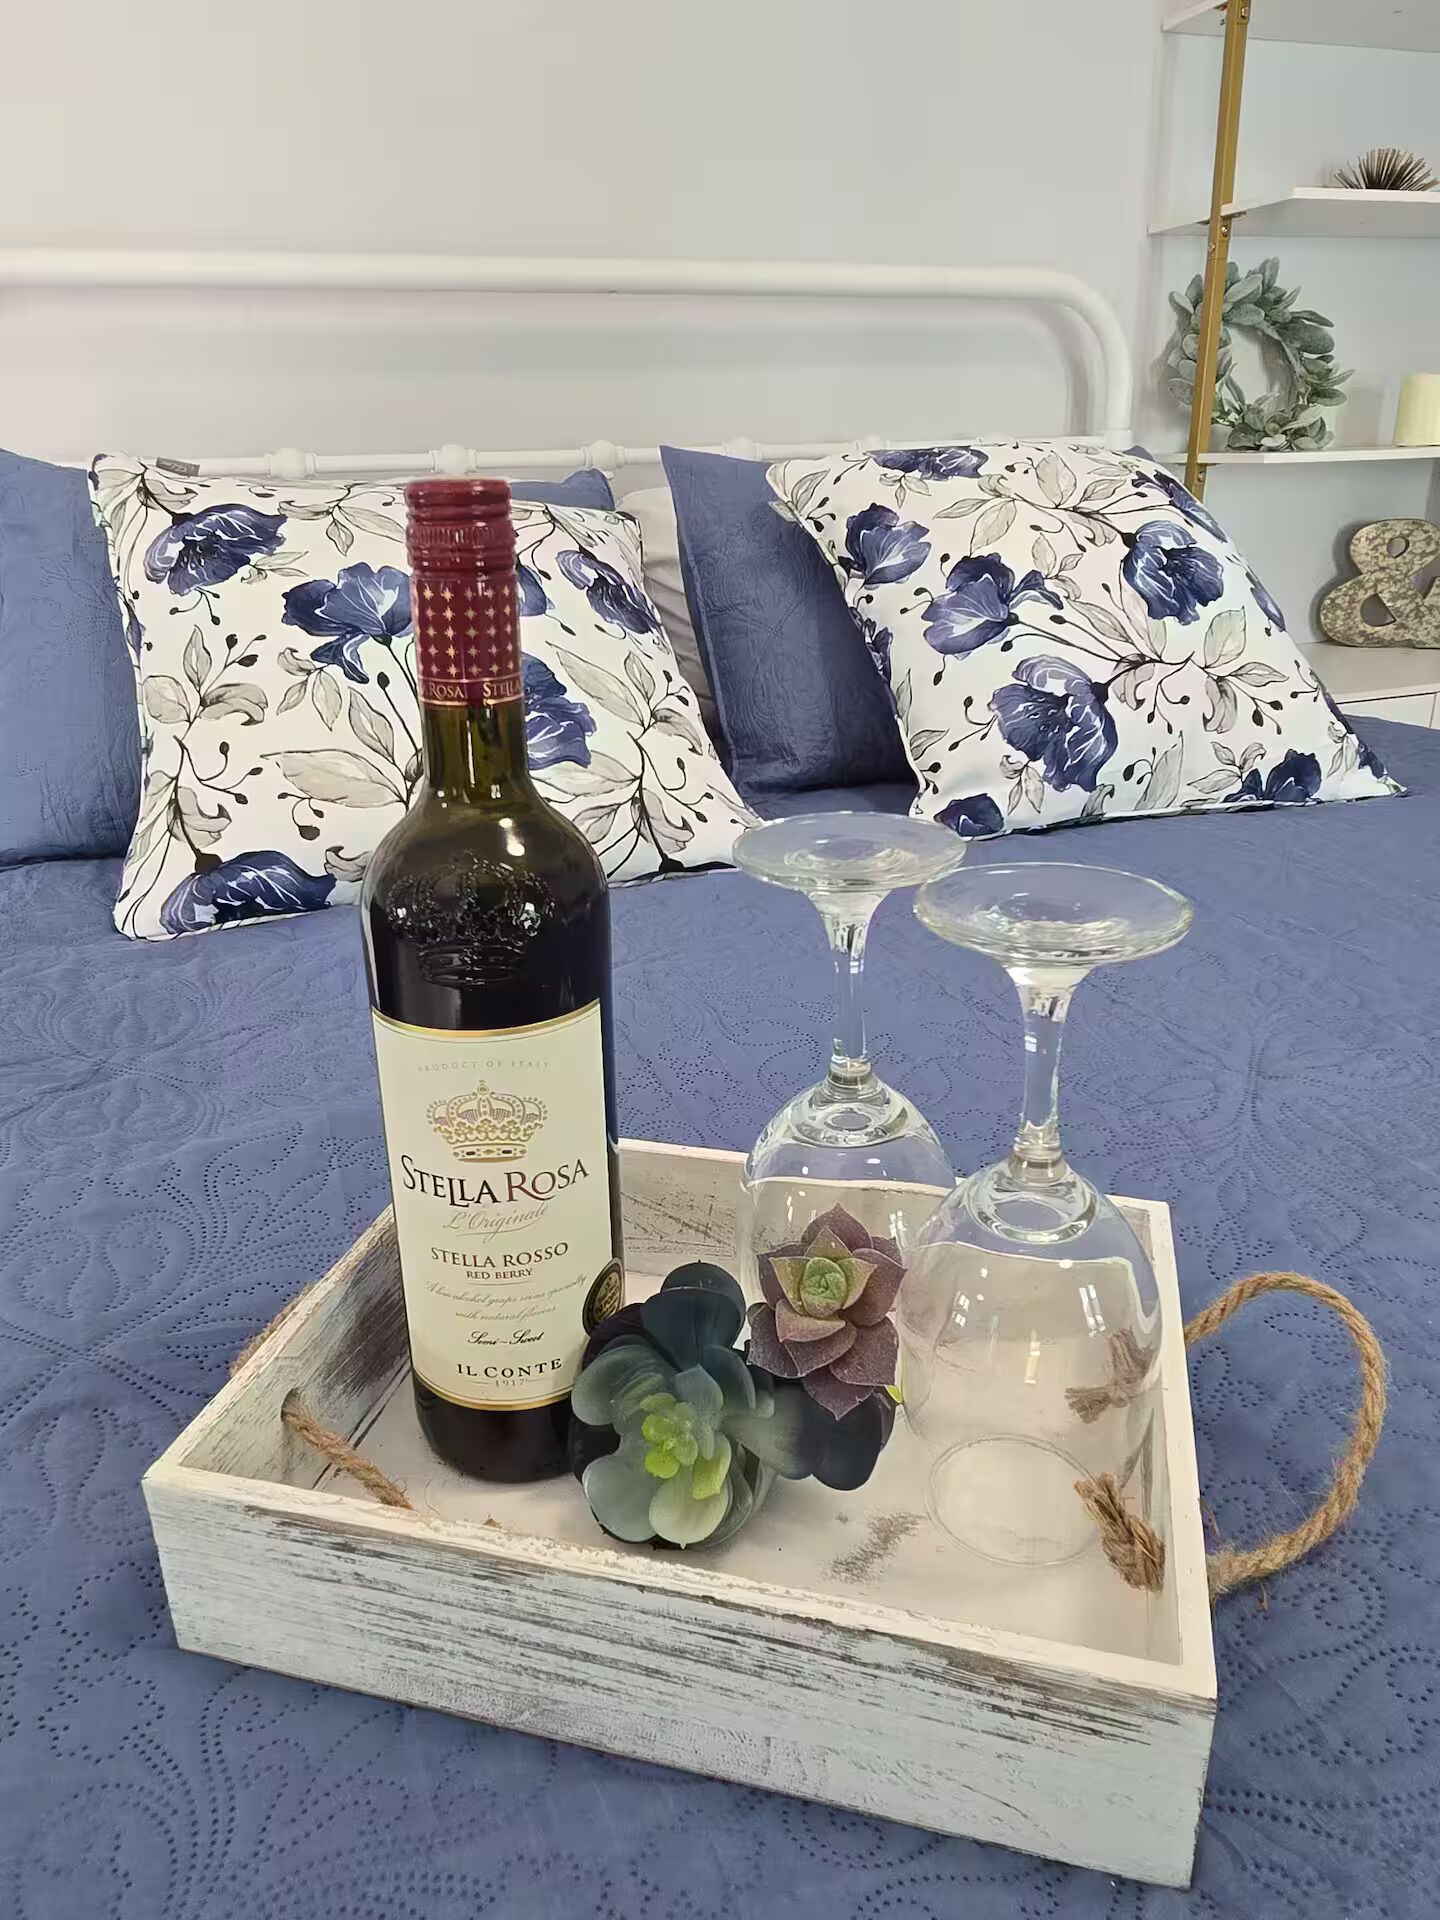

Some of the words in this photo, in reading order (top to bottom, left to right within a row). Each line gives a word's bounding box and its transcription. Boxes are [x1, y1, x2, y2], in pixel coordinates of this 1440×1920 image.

[429, 682, 464, 701] ROSA
[400, 1154, 501, 1207] STELLA
[504, 1159, 590, 1202] ROSA
[442, 1205, 549, 1243] L'Originale
[431, 1247, 497, 1268] STELLA
[503, 1242, 570, 1266] ROSSO
[466, 1270, 491, 1280] RED
[495, 1268, 533, 1279] BERRY
[457, 1363, 478, 1377] IL
[484, 1358, 562, 1378] CONTE
